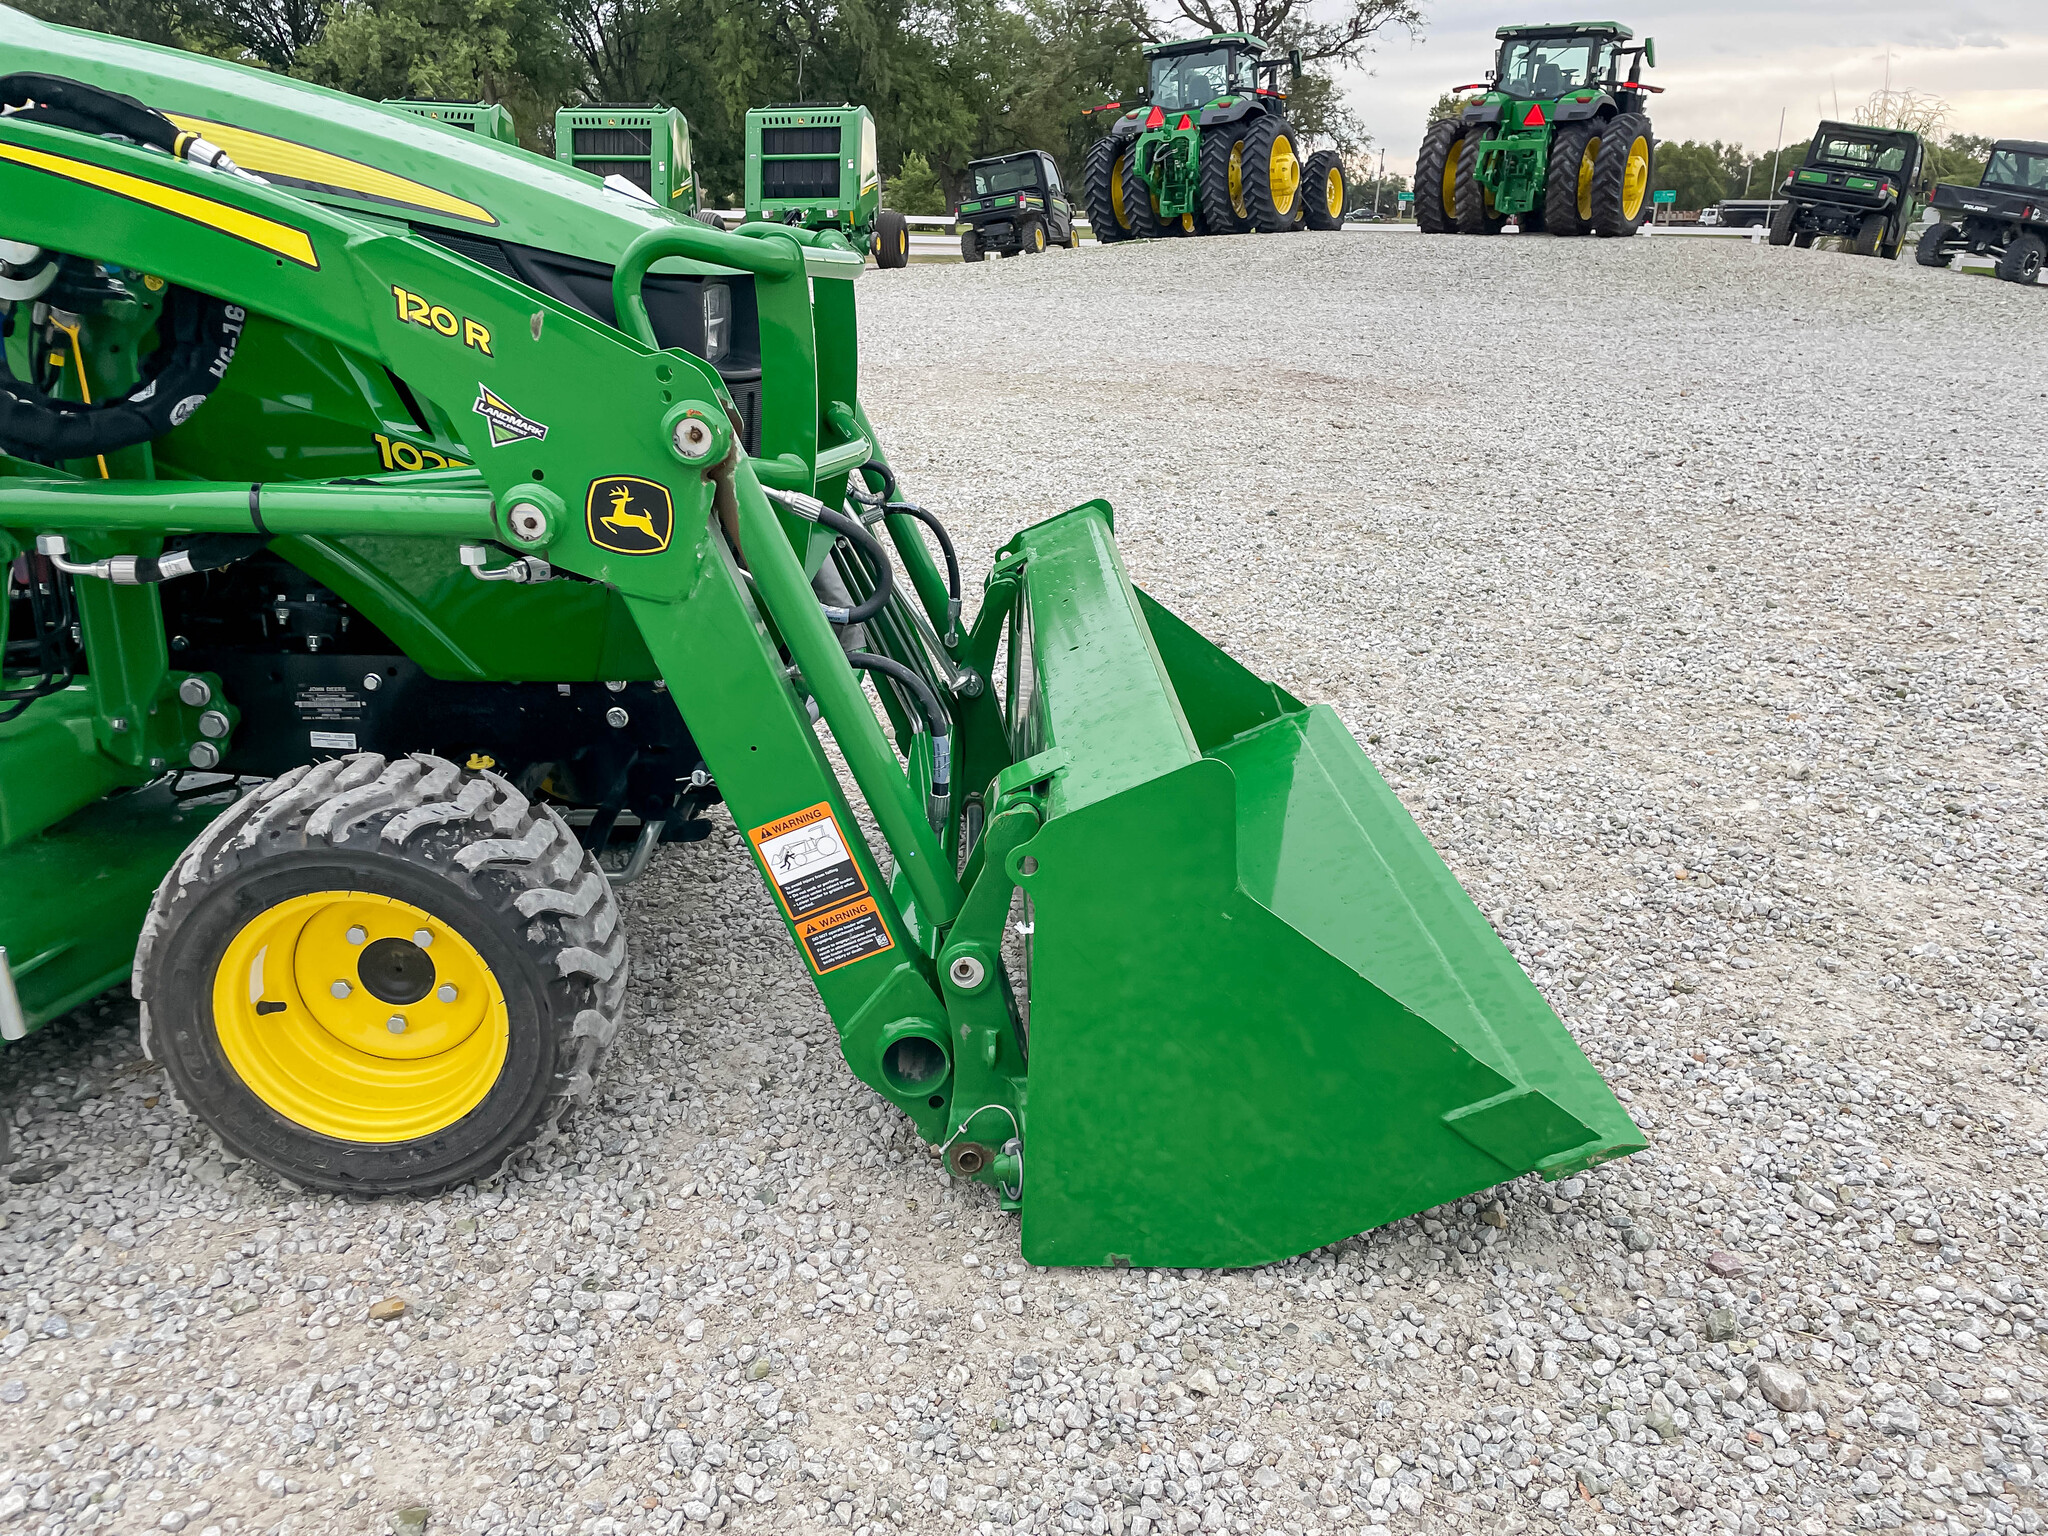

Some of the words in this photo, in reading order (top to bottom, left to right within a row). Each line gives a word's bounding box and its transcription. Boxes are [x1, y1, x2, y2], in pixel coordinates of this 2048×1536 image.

[1963, 204, 1989, 212] POLARIS
[392, 285, 459, 337] 120
[463, 317, 494, 358] R
[478, 402, 544, 437] LANDMARK
[491, 418, 528, 435] IMPLEMENT
[771, 809, 822, 834] WARNING
[819, 904, 868, 928] WARNING
